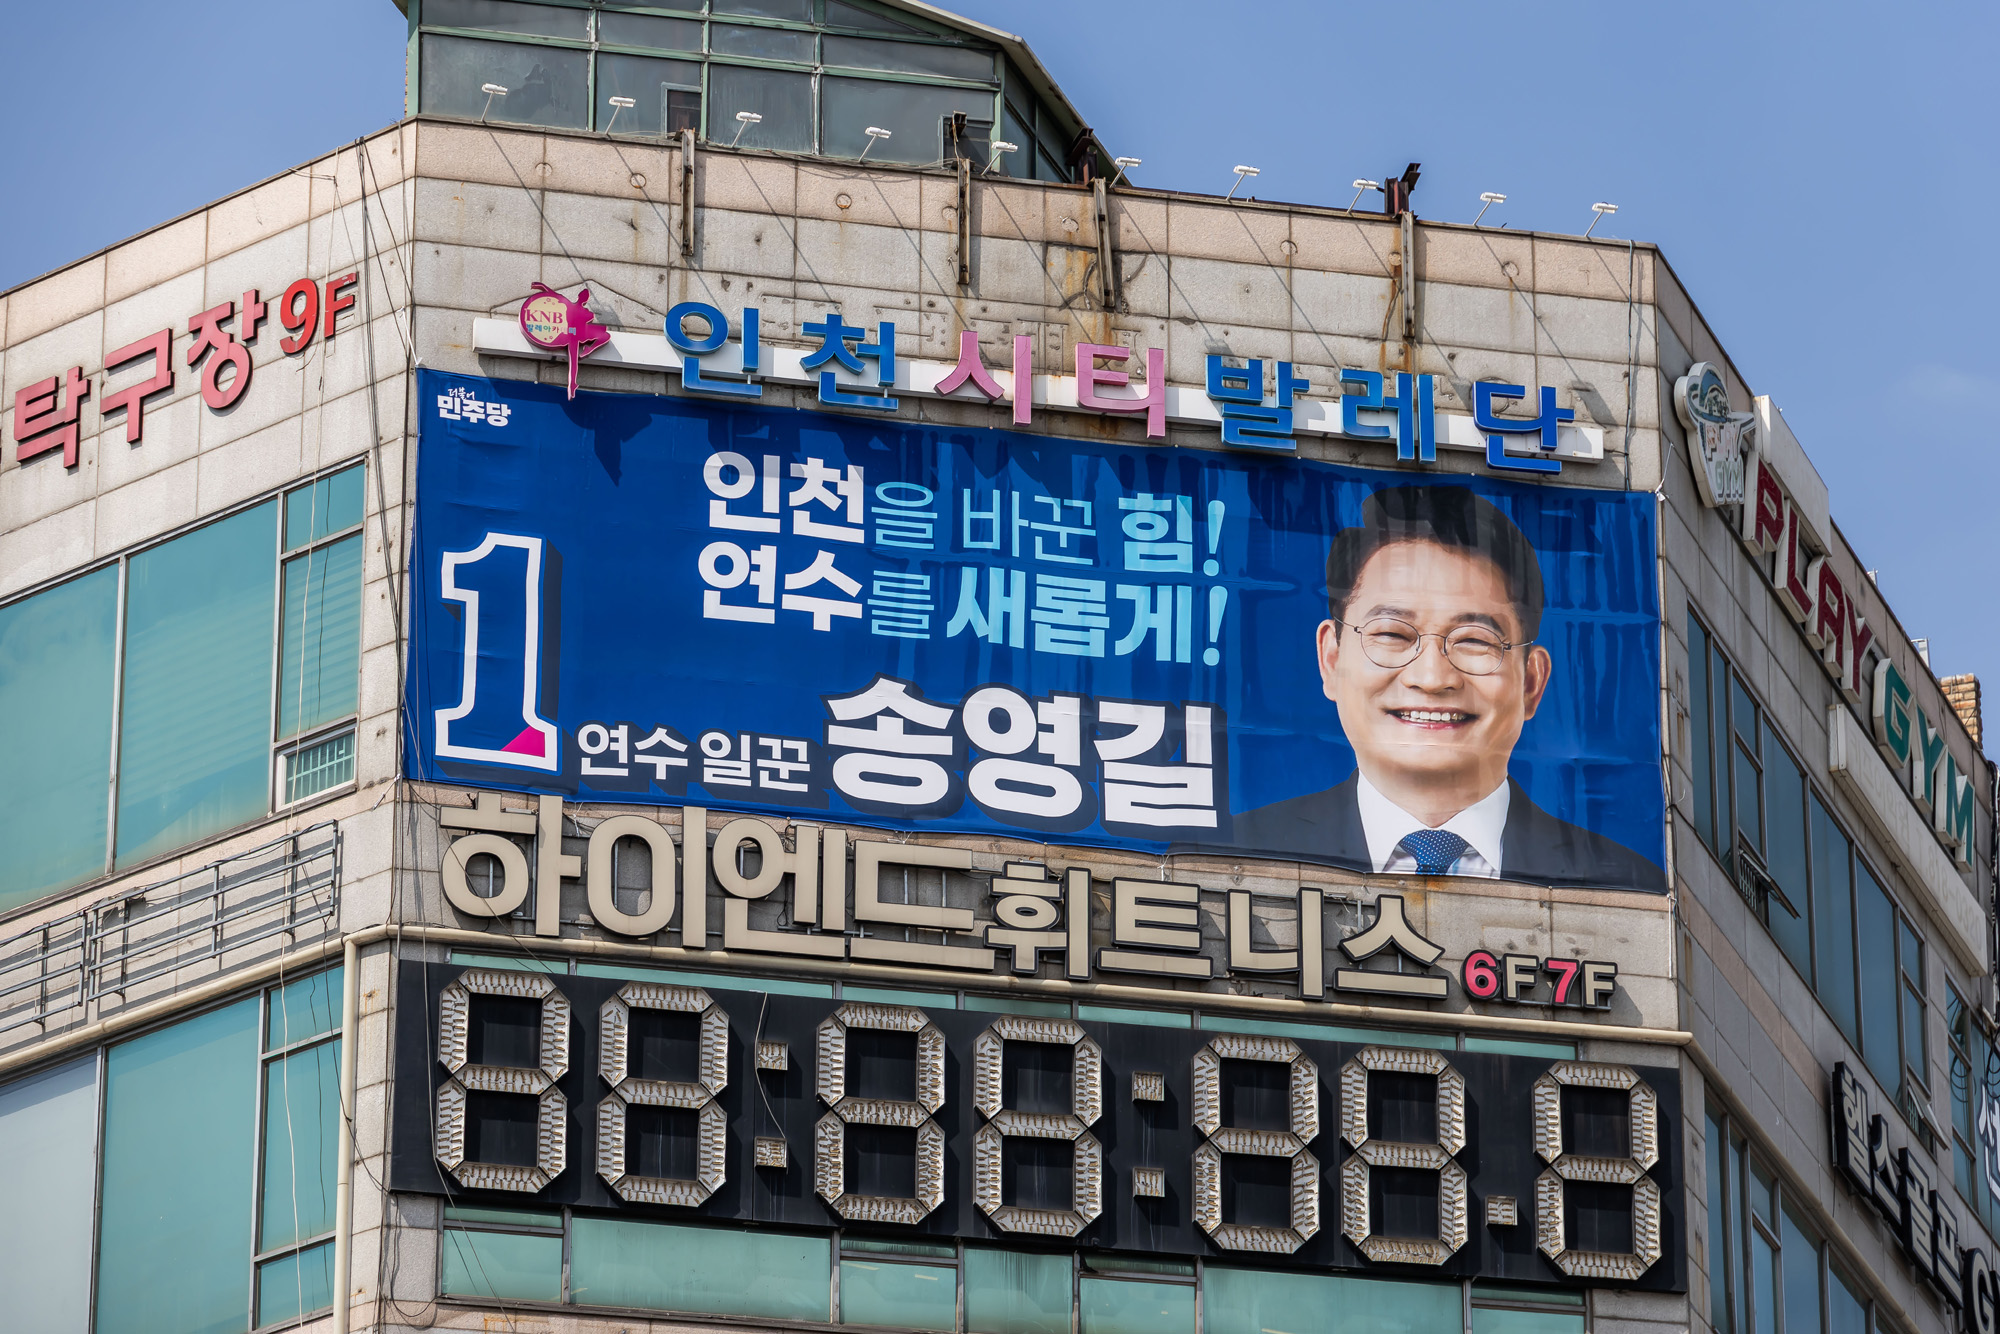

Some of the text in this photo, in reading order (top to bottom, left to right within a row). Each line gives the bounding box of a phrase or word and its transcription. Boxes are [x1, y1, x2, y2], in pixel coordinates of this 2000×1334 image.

[14, 272, 359, 469] 탁구장 9F
[525, 308, 564, 324] KNB
[437, 394, 512, 427] 민주당
[447, 386, 476, 401] 더불어
[703, 451, 1226, 577] 인천을 바꾼 힘!
[434, 531, 558, 772] 1
[698, 541, 1228, 666] 연수를 새롭게!
[1748, 453, 1976, 873] PLAY GYM
[827, 677, 1218, 827] 송영길
[1838, 1064, 1964, 1308] 헬스골프
